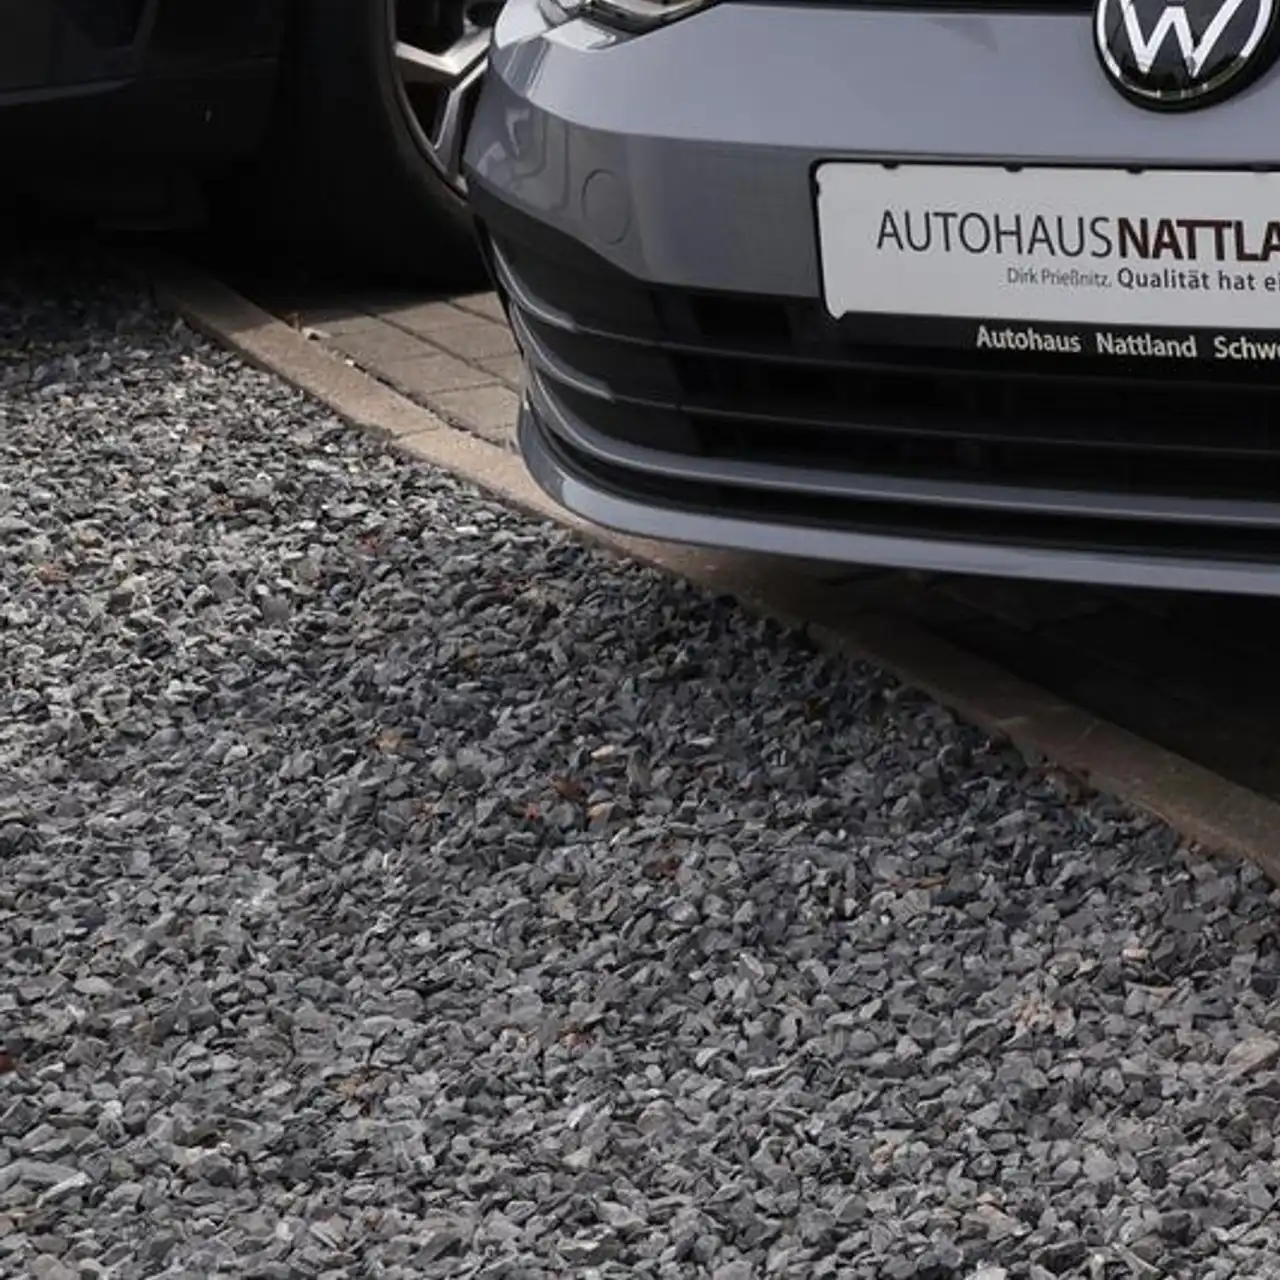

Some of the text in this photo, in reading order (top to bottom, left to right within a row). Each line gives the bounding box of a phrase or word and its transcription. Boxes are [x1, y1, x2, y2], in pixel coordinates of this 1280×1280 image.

[1006, 267, 1038, 285] Dirk
[1116, 267, 1210, 291] Qualität
[1218, 271, 1256, 292] hat
[976, 324, 1082, 353] Autohaus
[1096, 332, 1198, 358] Nattland
